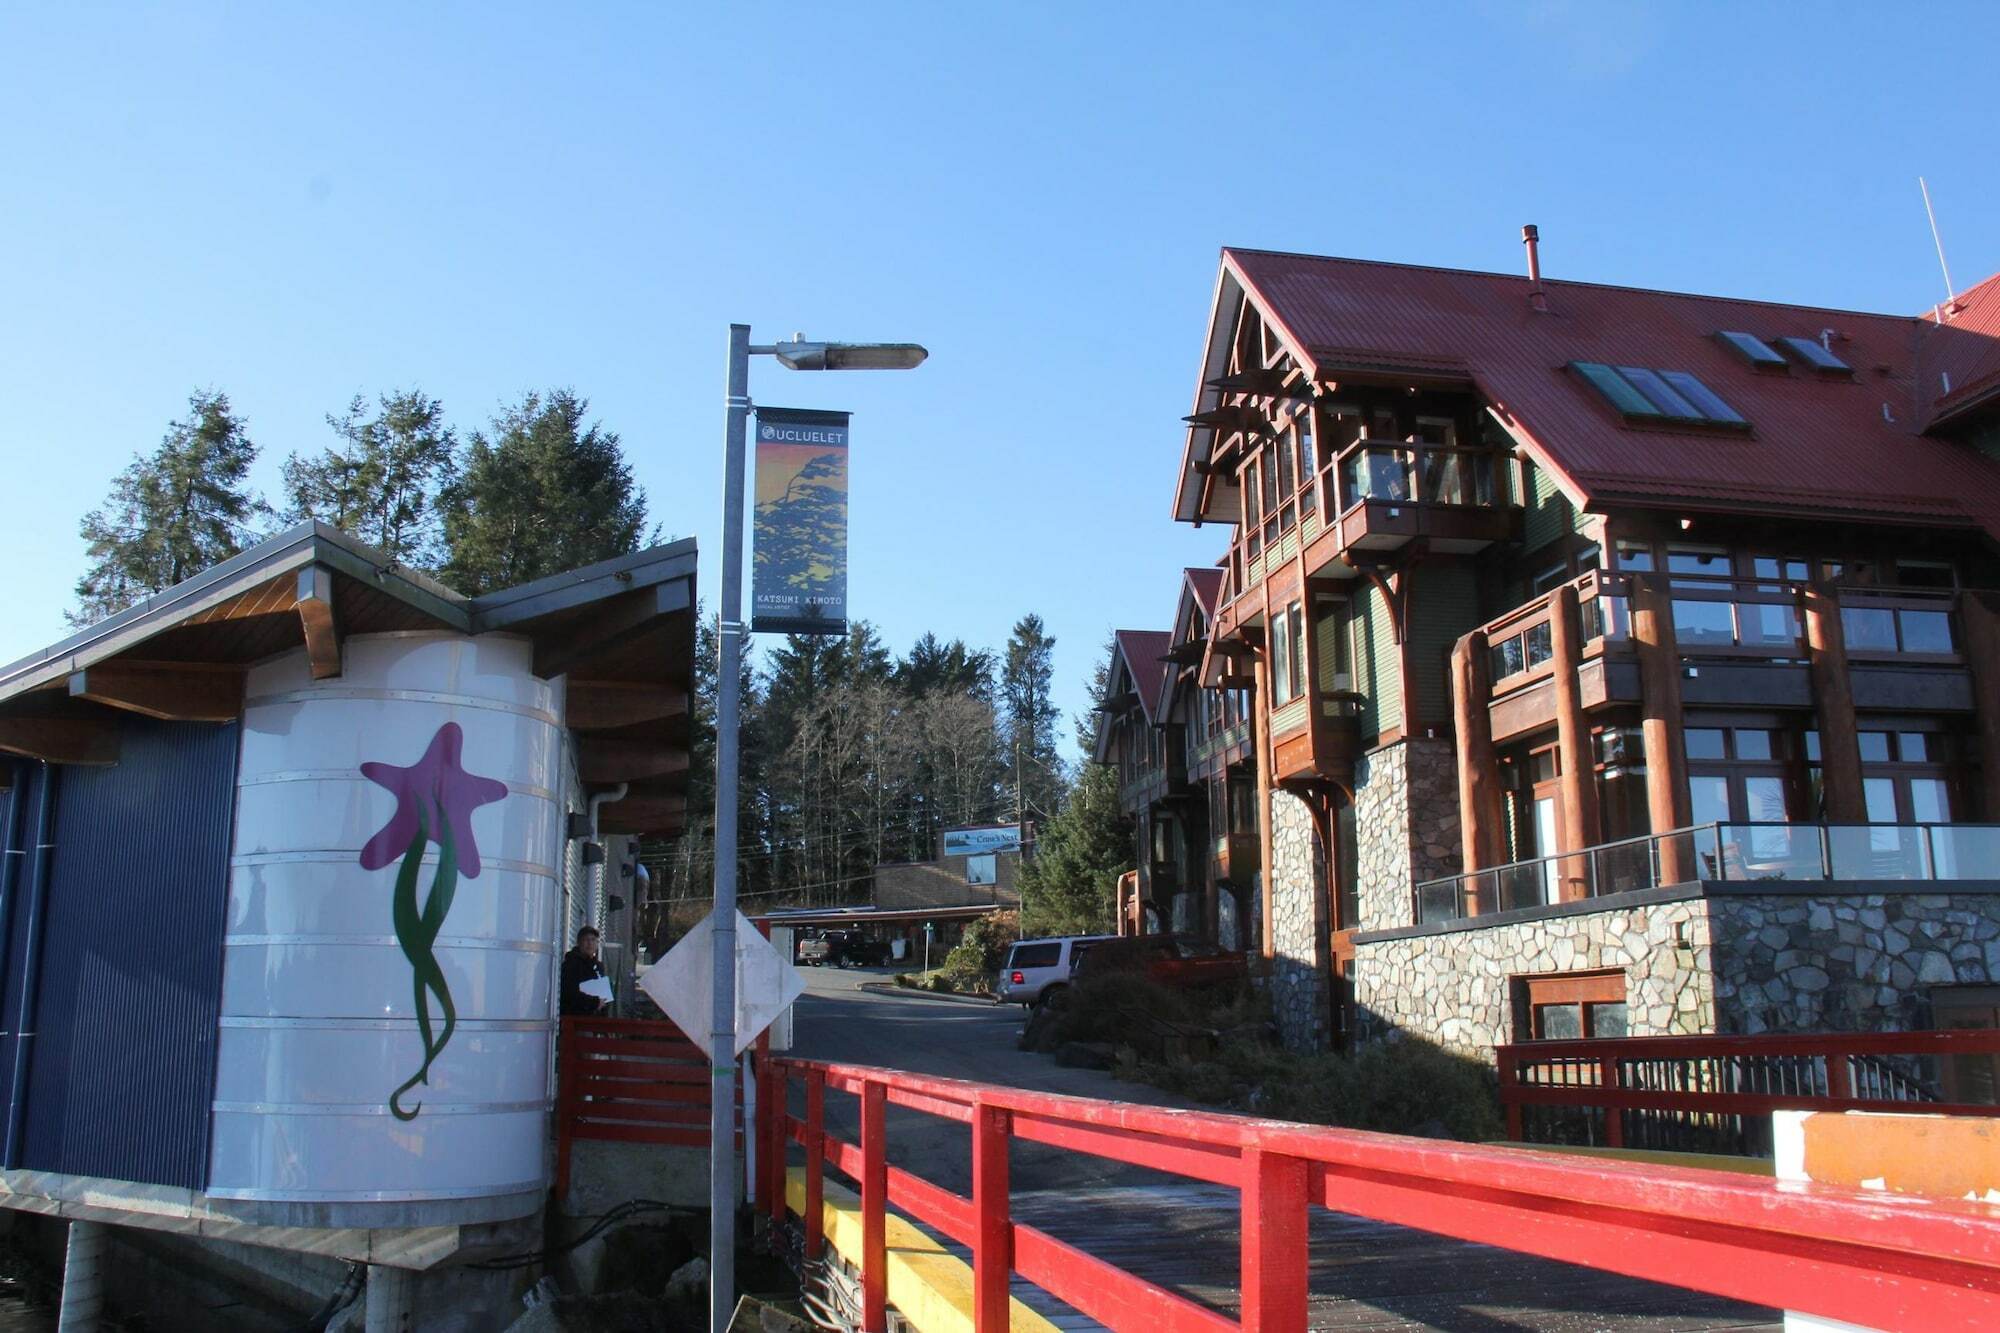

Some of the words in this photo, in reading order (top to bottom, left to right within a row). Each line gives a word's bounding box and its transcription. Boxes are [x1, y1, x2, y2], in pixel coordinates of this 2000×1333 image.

[776, 430, 843, 443] UCLUELET
[757, 595, 799, 604] KATSUMI
[805, 597, 842, 605] KIMOTO
